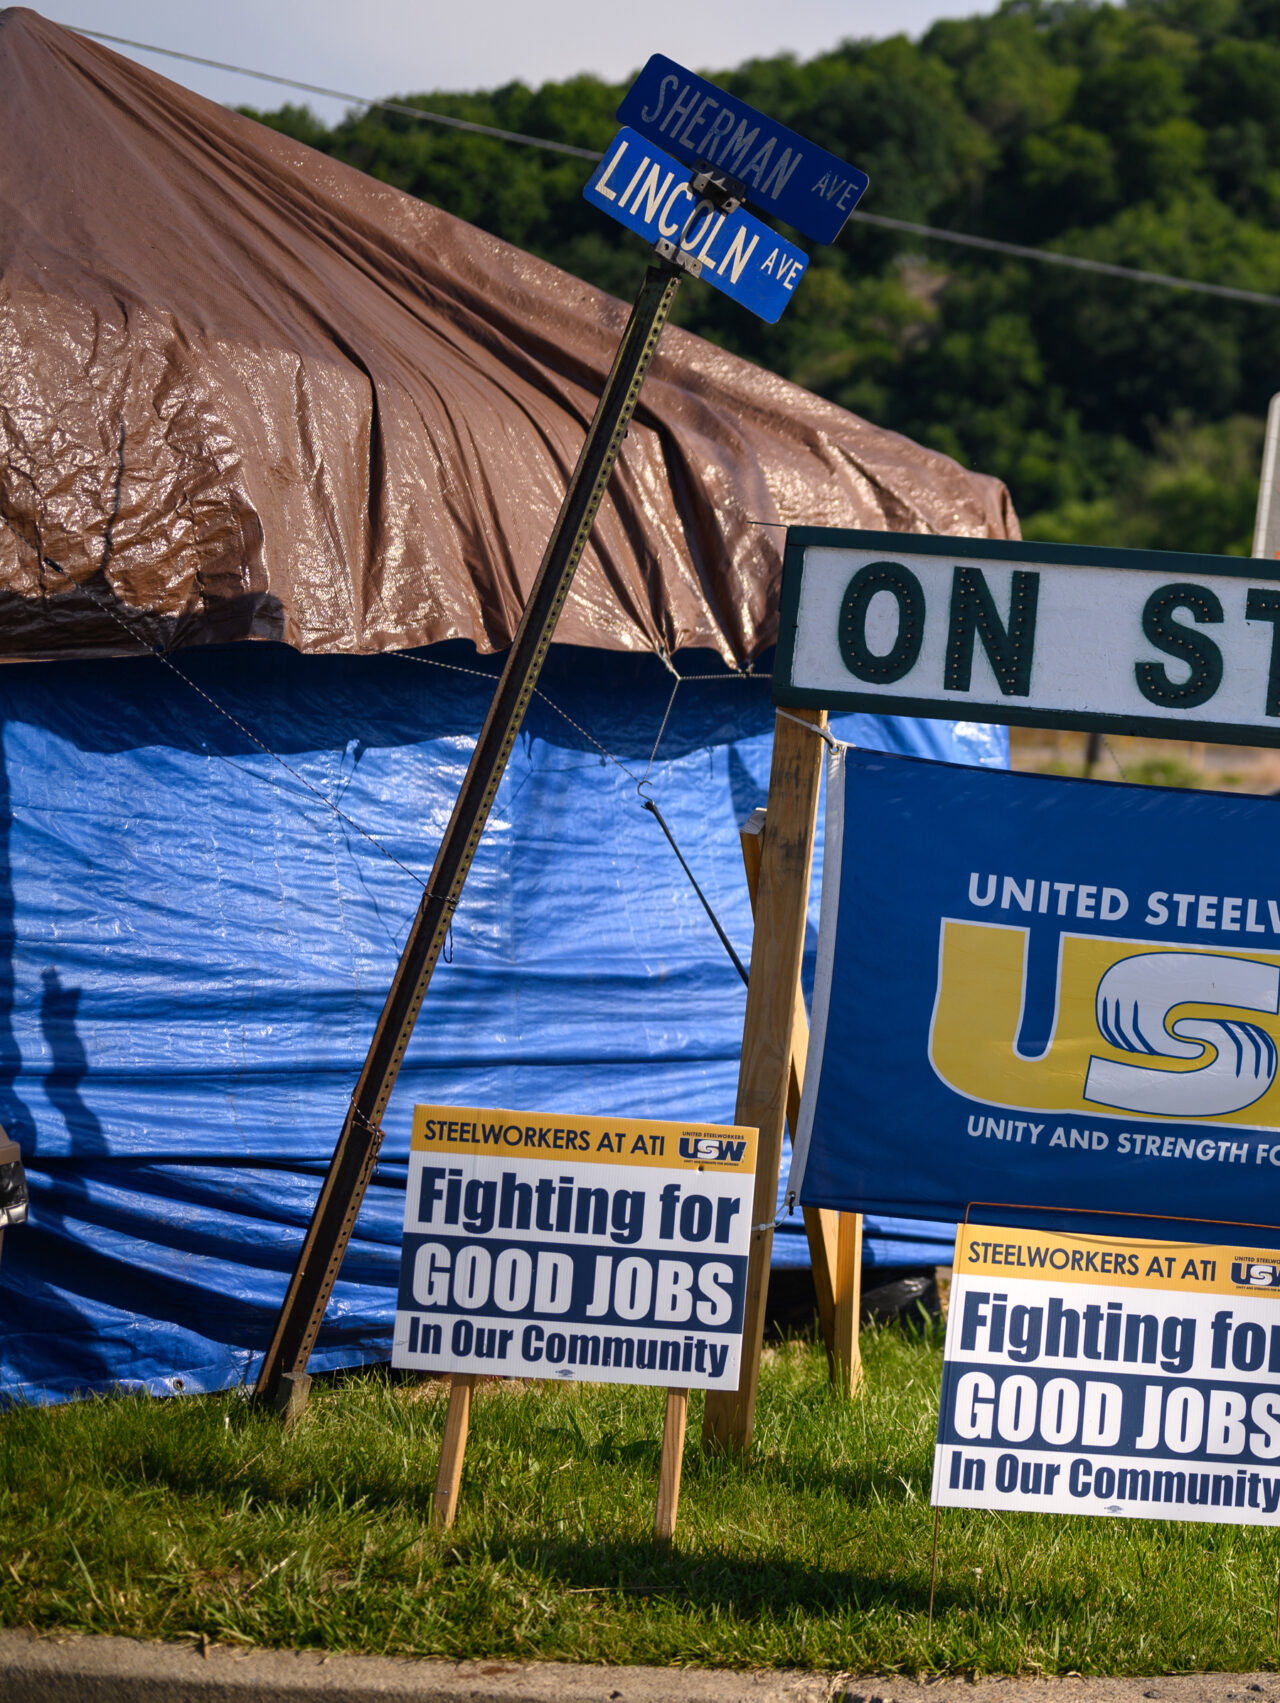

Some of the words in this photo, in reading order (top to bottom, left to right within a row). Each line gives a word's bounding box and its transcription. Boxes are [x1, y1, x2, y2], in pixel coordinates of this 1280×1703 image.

[641, 74, 802, 200] SHERMAN
[811, 172, 859, 211] AVE
[594, 141, 760, 285] LINCOLN
[760, 248, 803, 290] AVE
[838, 561, 1040, 697] ON
[968, 872, 1129, 921] UNITED
[424, 1119, 590, 1152] STEELWORKERS
[596, 1132, 626, 1153] AT
[630, 1134, 665, 1156] ATI
[679, 1137, 747, 1162] USW
[967, 1115, 1045, 1146] UNITY
[1049, 1126, 1109, 1151] AND
[1116, 1133, 1250, 1165] STRENGTH
[417, 1166, 646, 1245] Fighting
[659, 1183, 741, 1244] for
[412, 1242, 574, 1315] GOOD
[586, 1255, 734, 1326] JOBS
[968, 1240, 1139, 1276] STEELWORKERS
[1145, 1256, 1176, 1278] AT
[1180, 1258, 1216, 1282] ATI
[407, 1316, 442, 1355] In
[451, 1319, 513, 1359] Our
[521, 1324, 729, 1378] Community
[960, 1290, 1197, 1374] Fighting
[953, 1371, 1123, 1448] GOOD
[949, 1450, 986, 1491] In
[995, 1453, 1060, 1495] Our
